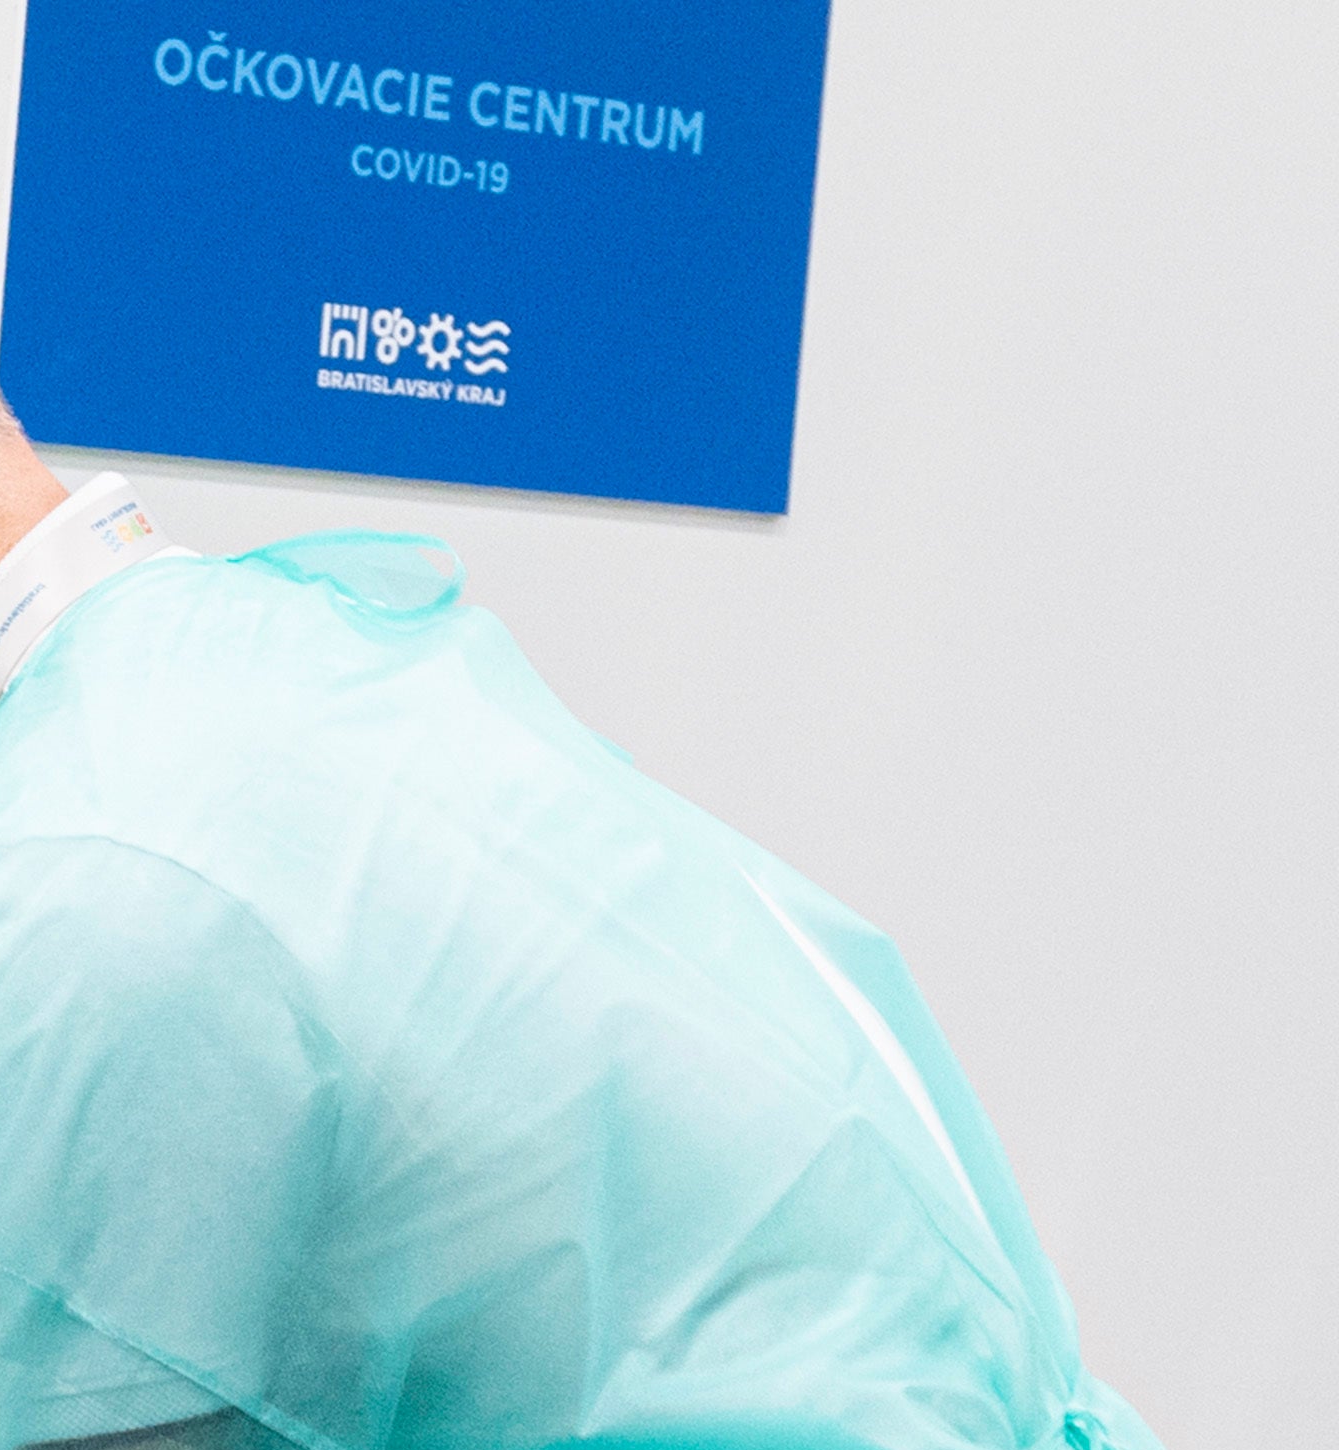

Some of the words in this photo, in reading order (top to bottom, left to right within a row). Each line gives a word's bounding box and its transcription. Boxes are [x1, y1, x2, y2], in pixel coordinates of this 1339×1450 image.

[154, 30, 452, 121] OČKOVACIE
[469, 81, 705, 154] CENTRUM
[350, 144, 510, 194] COVID-19
[316, 368, 454, 401] BRATISLAVSKÝ
[455, 384, 507, 406] KRAJ
